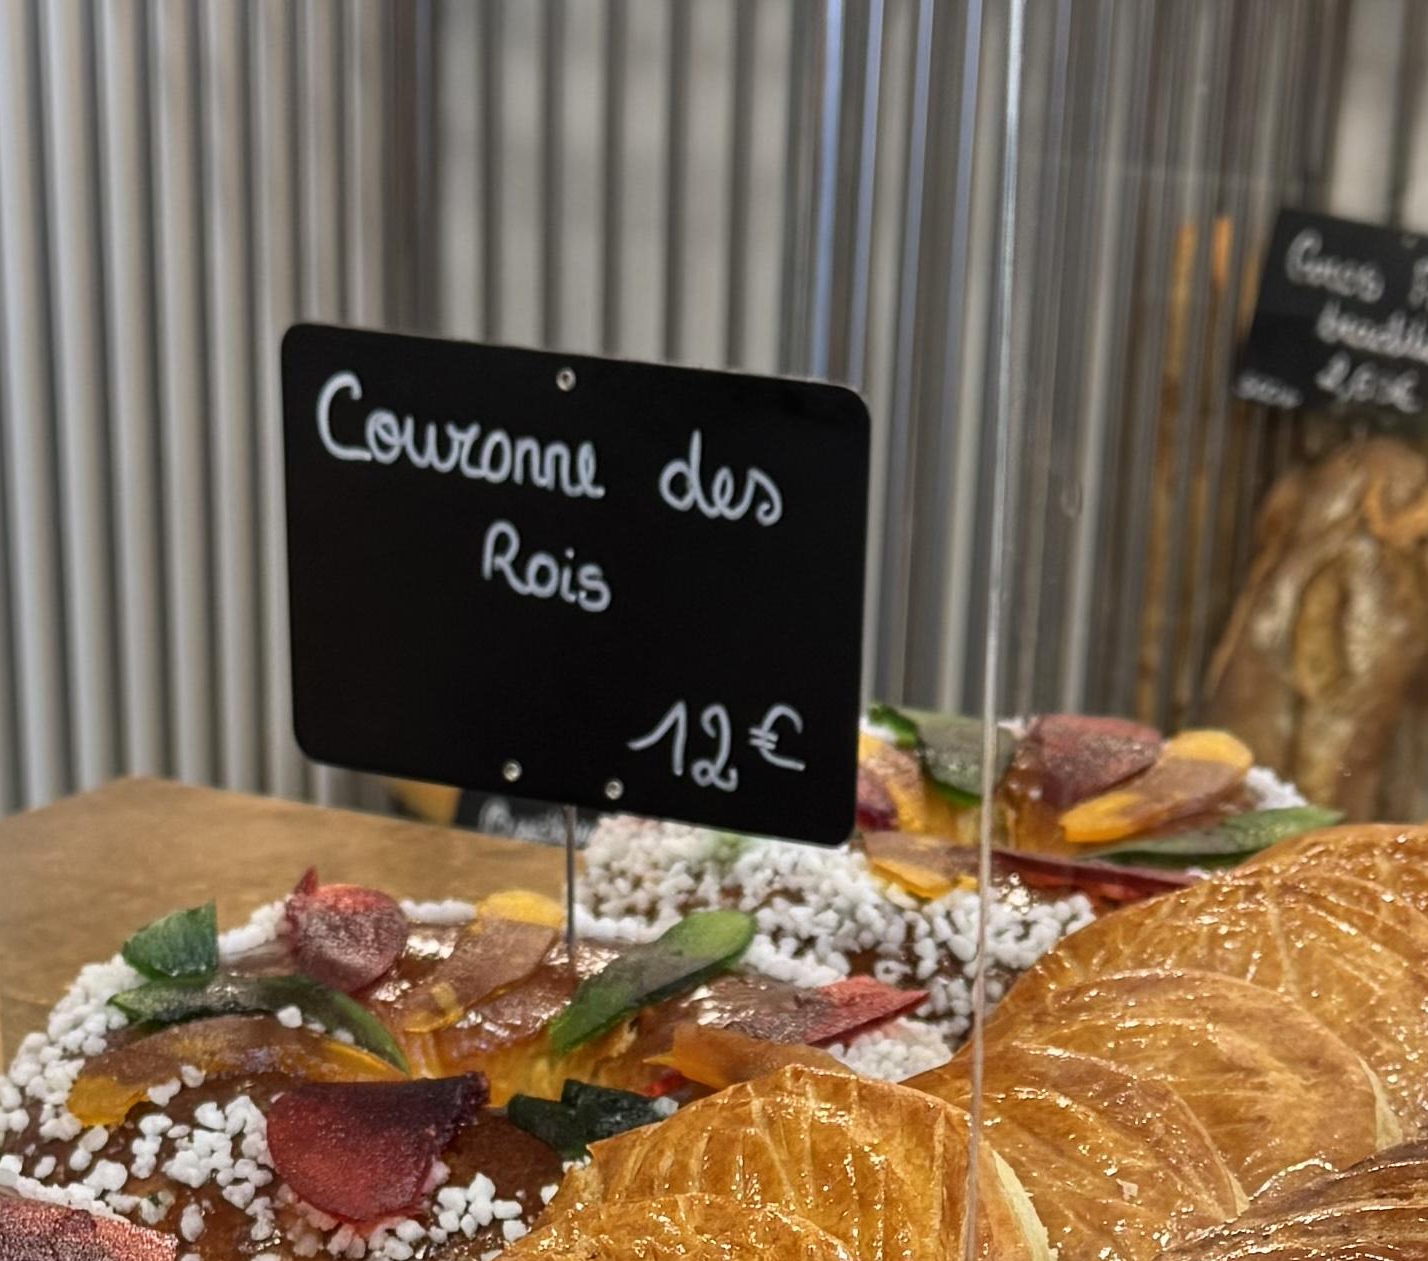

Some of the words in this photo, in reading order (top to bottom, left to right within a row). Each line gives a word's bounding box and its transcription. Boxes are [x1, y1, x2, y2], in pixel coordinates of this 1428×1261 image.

[316, 370, 606, 500] Couronne
[658, 429, 784, 526] des
[481, 520, 612, 612] Rois
